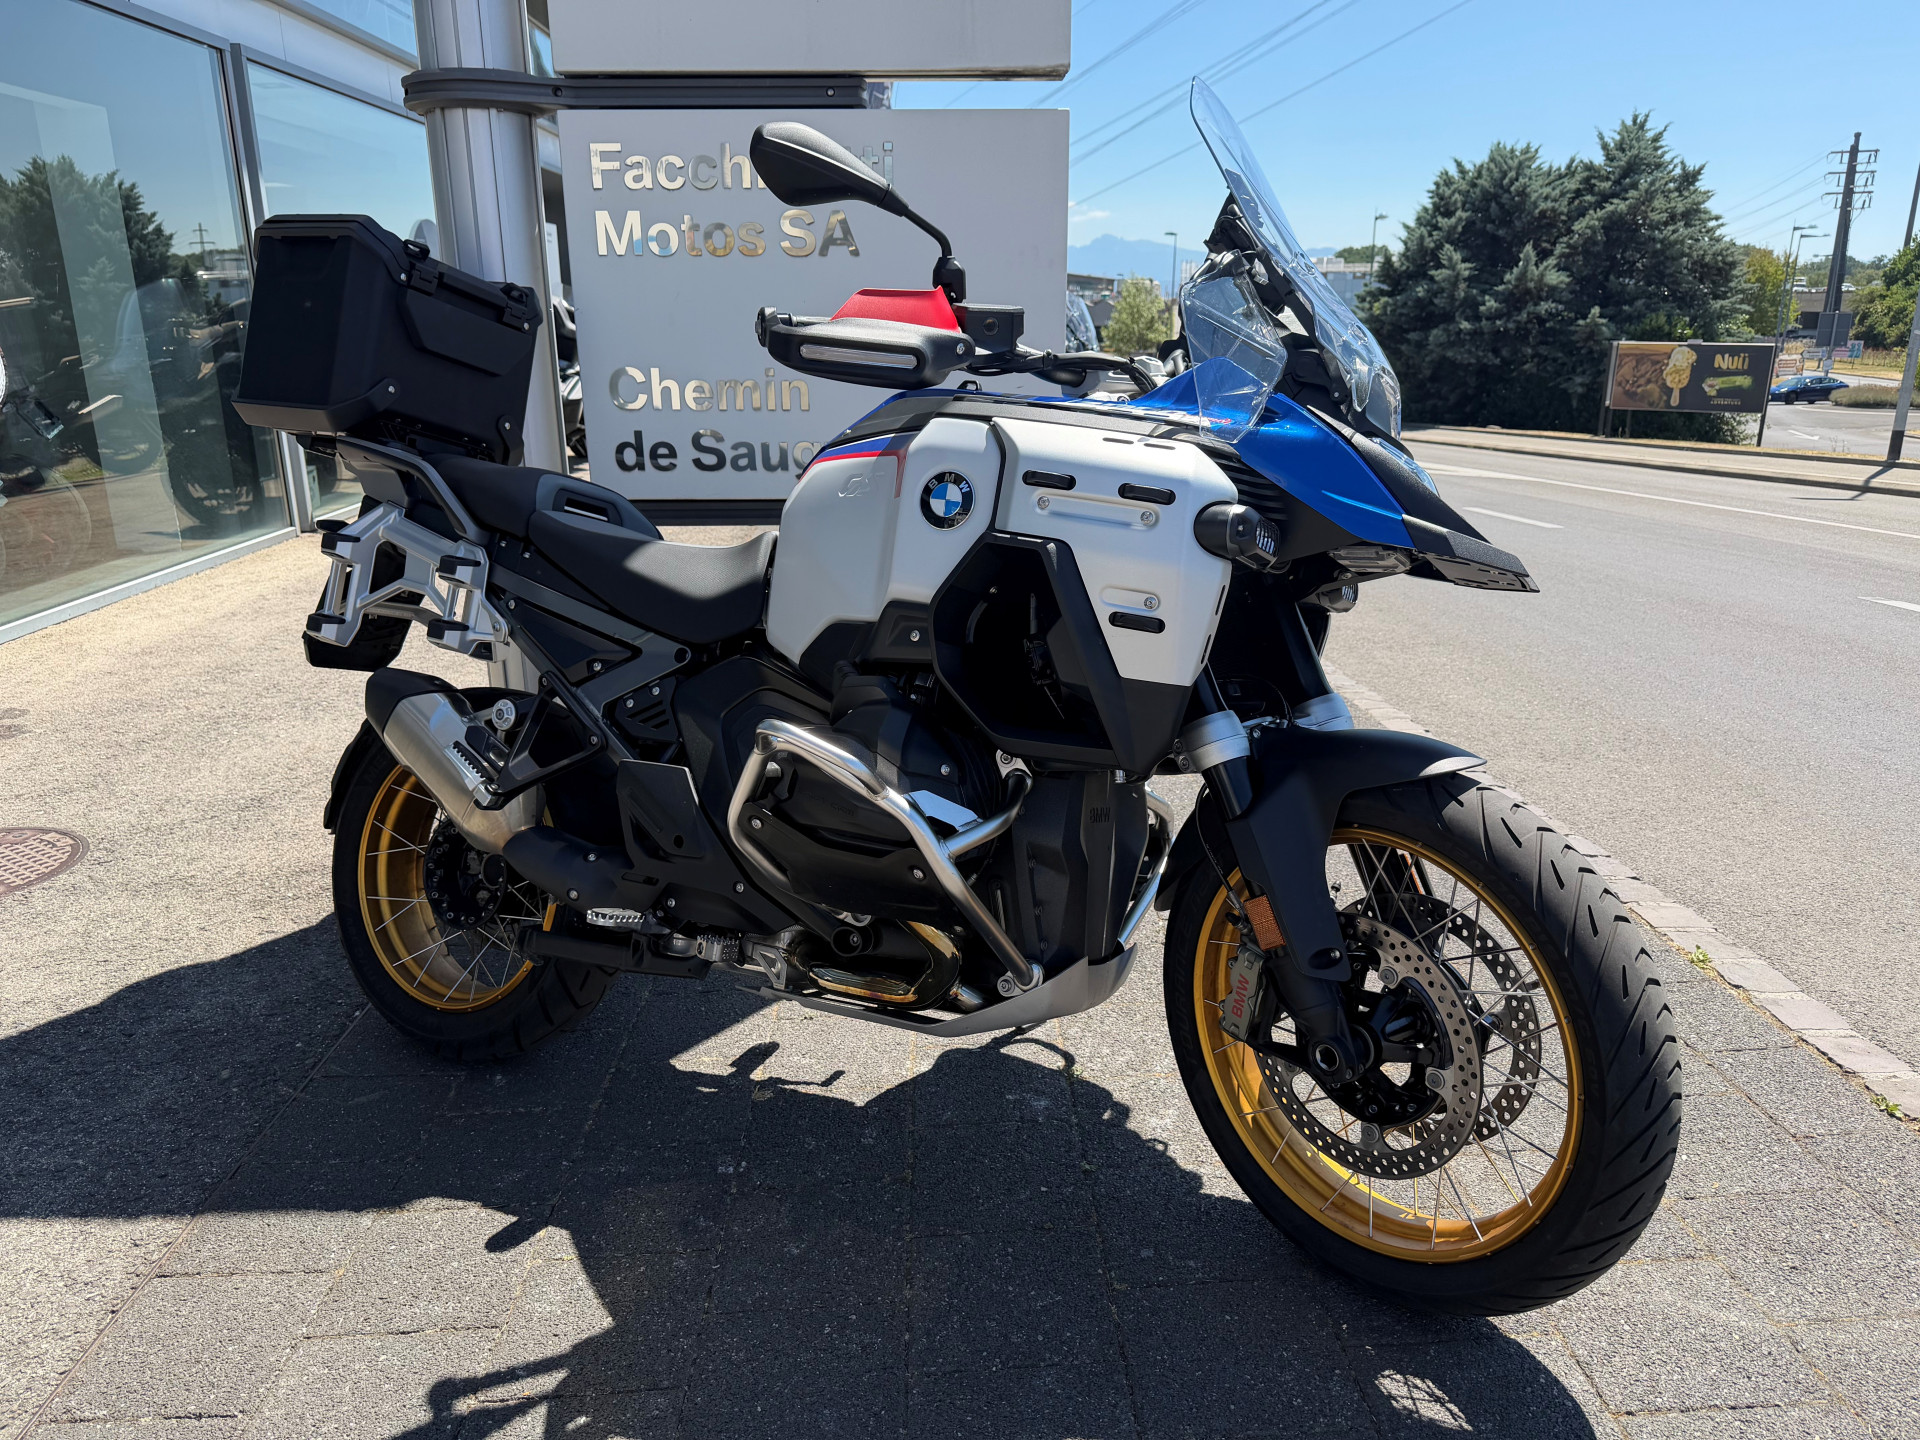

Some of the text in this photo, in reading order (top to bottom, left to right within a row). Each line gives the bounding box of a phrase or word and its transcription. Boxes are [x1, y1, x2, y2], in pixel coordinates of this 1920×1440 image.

[588, 141, 895, 190] Facchti
[594, 209, 862, 258] Motos SA
[608, 366, 811, 413] Chemin
[614, 429, 826, 480] de Saug
[1089, 806, 1111, 824] BMW
[1231, 972, 1250, 1019] BMW
